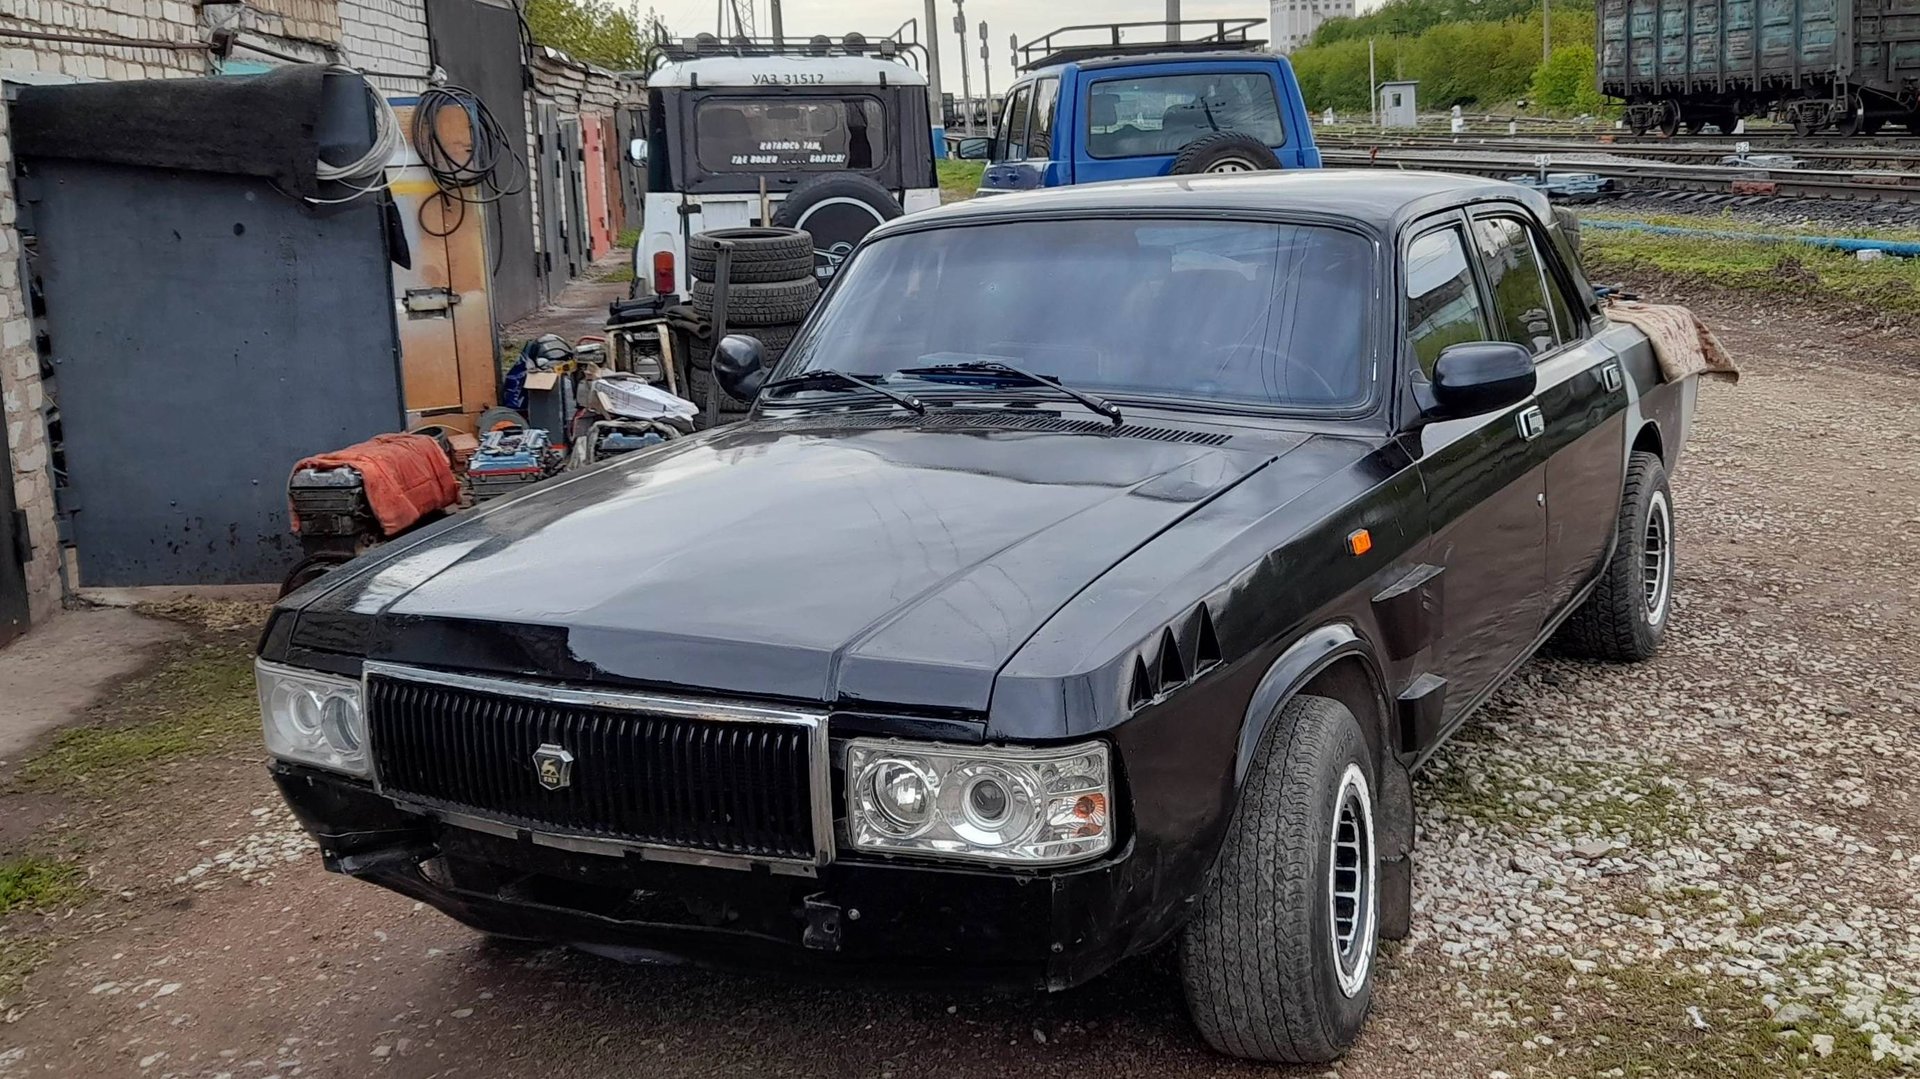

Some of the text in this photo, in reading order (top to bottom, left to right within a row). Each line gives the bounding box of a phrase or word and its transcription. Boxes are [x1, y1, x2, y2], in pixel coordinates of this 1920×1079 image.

[752, 74, 824, 85] УАЗ 31512
[759, 141, 800, 151] КАТАЮСЬ
[731, 155, 748, 164] ГДЕ
[750, 155, 778, 164] ВОЛКИ
